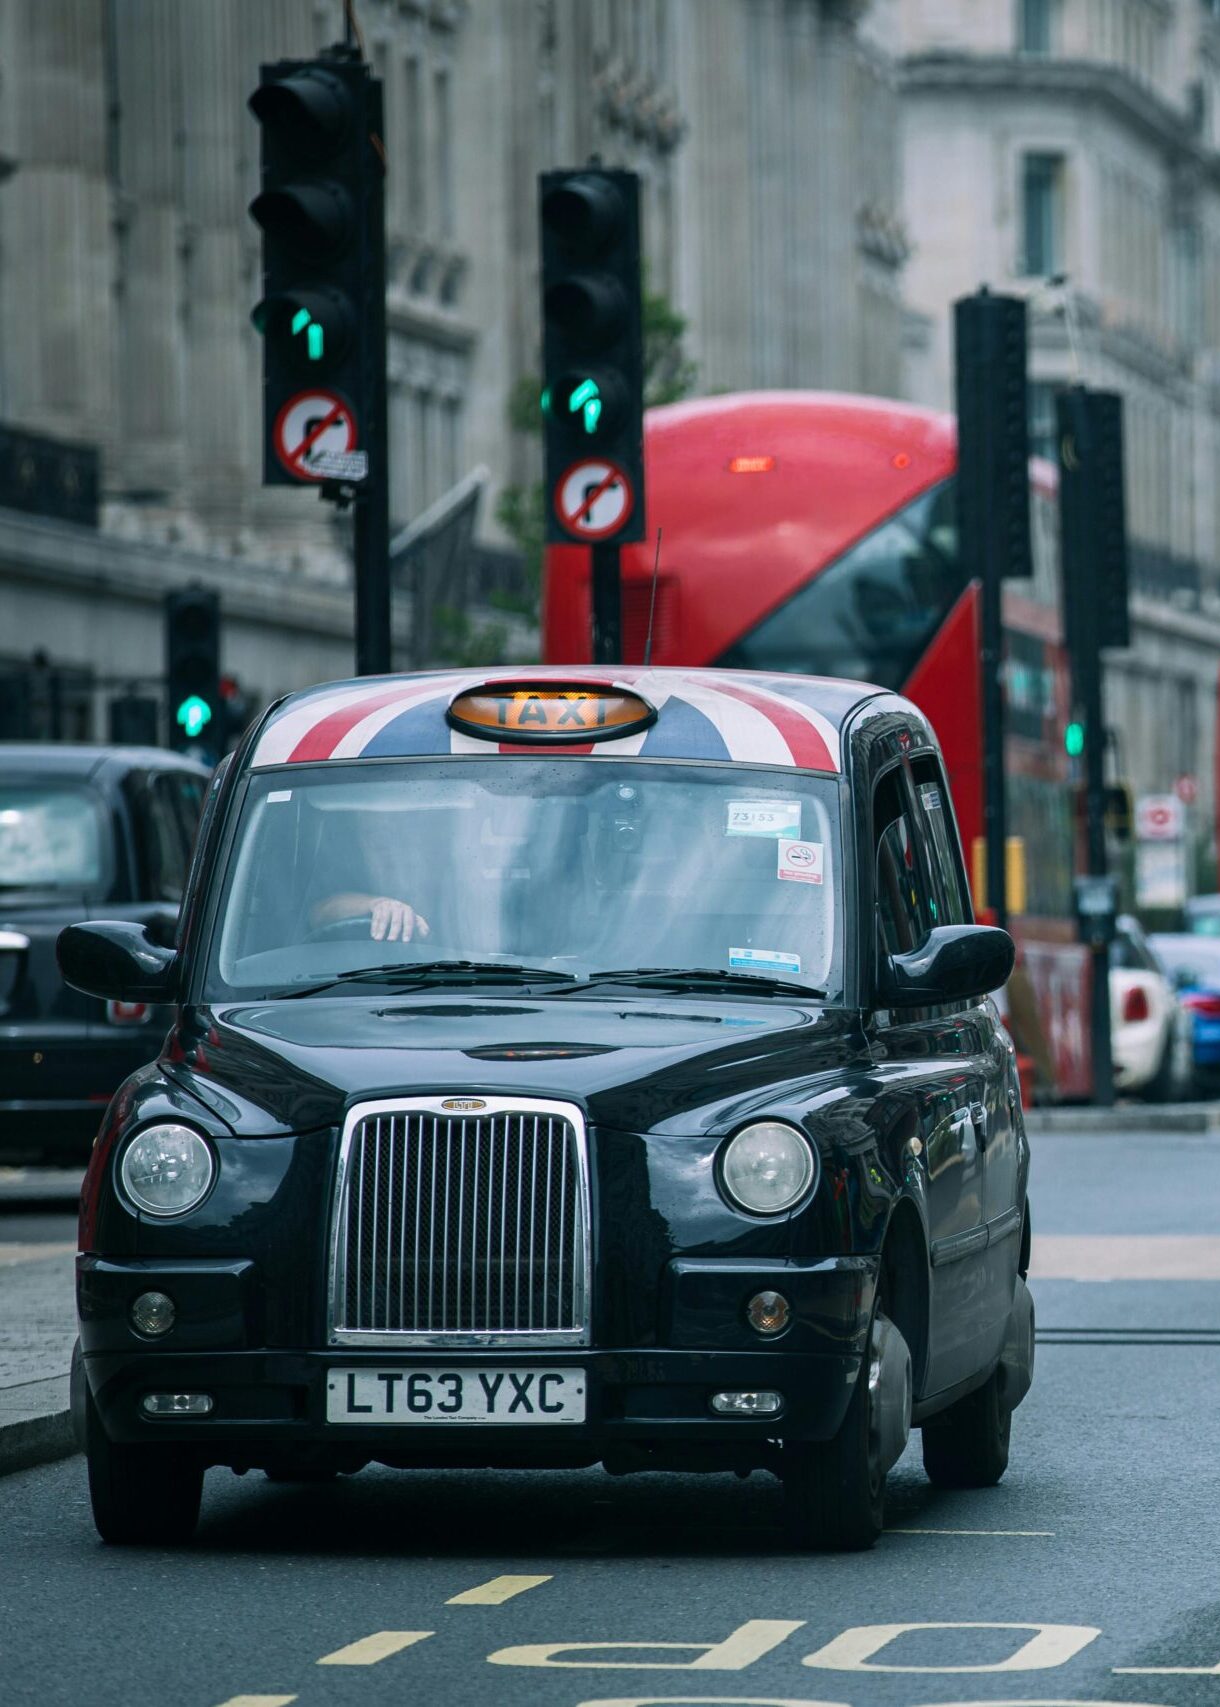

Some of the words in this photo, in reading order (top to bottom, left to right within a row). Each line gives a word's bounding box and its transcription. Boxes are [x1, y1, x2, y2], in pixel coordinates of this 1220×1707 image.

[490, 695, 606, 725] TAXI
[347, 1373, 463, 1413] LT63
[478, 1373, 565, 1413] YXC
